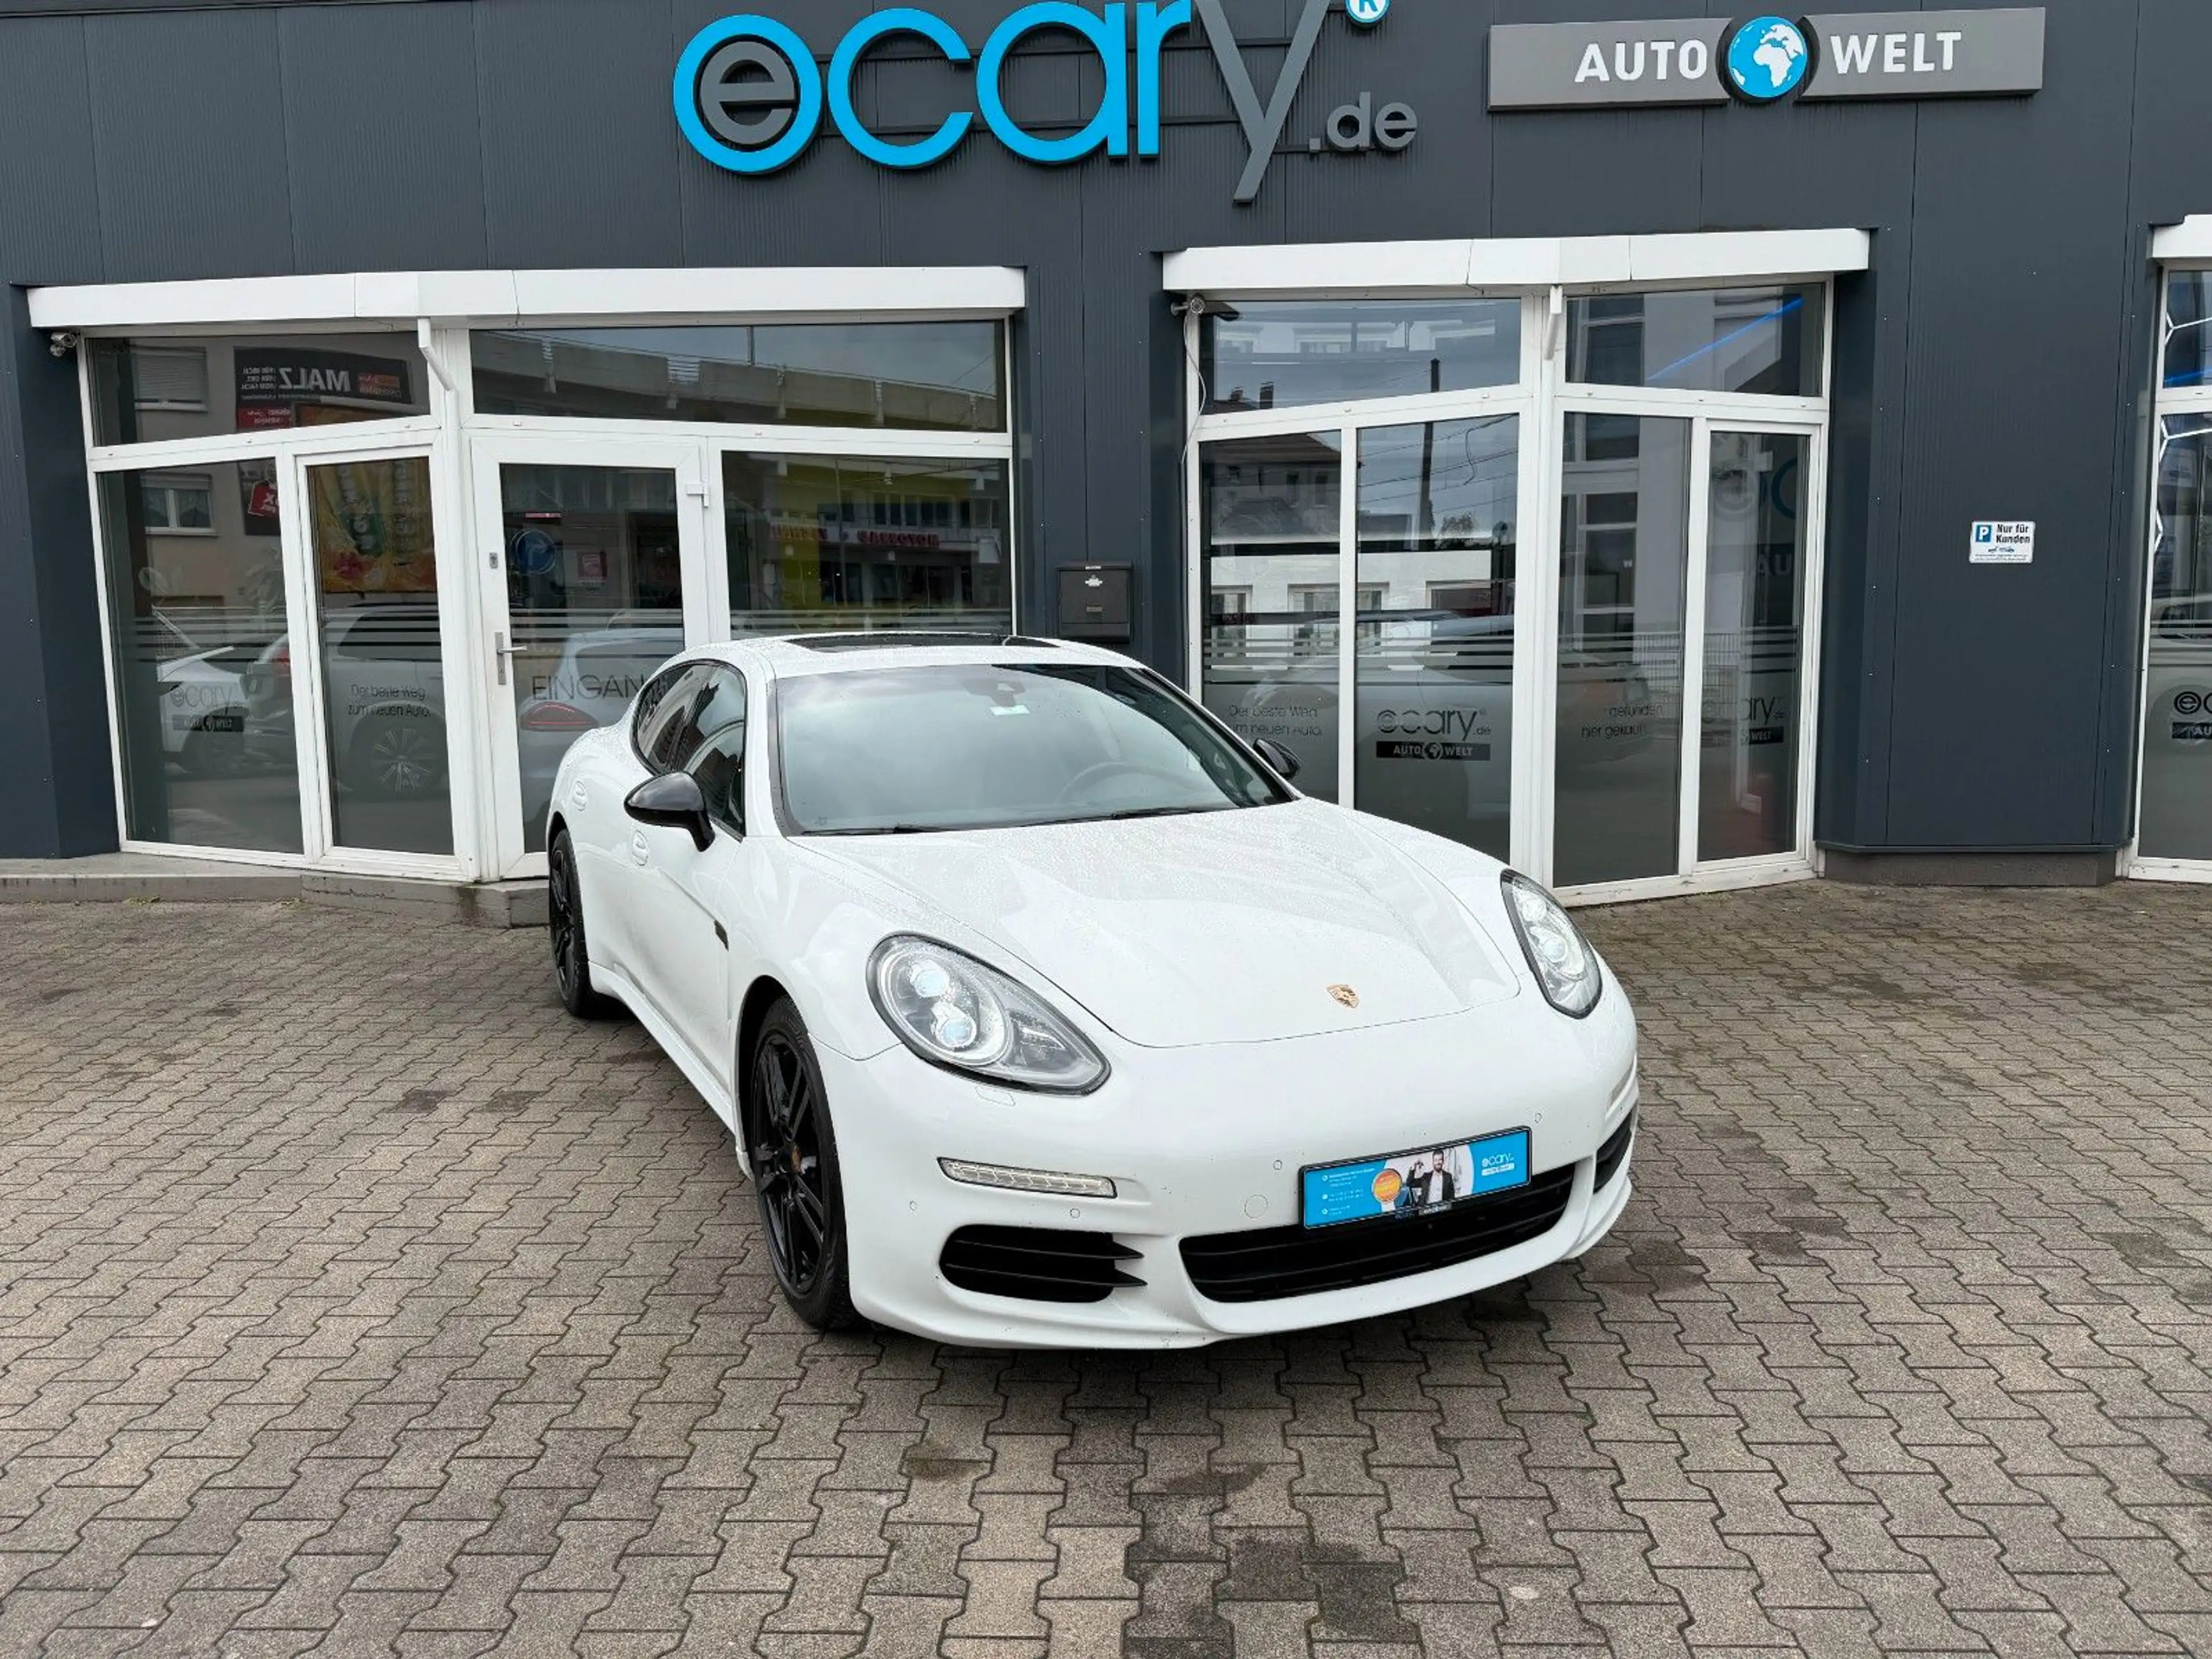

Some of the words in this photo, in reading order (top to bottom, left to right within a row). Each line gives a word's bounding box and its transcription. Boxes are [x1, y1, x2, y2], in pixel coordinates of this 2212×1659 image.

[1574, 39, 1708, 83] AUTO
[1830, 31, 1962, 75] WELT
[673, 0, 1328, 202] ecary
[1309, 91, 1418, 152] .de
[1997, 524, 2013, 533] Nur
[2016, 524, 2029, 533] für
[1996, 535, 2031, 544] Kunden
[532, 674, 644, 700] EINGAN
[1229, 704, 1248, 717] Der
[1253, 704, 1286, 718] beste
[1251, 724, 1289, 736] neuen
[1377, 709, 1478, 741] ecary
[1393, 744, 1421, 755] AUTO
[1445, 745, 1472, 756] WELT
